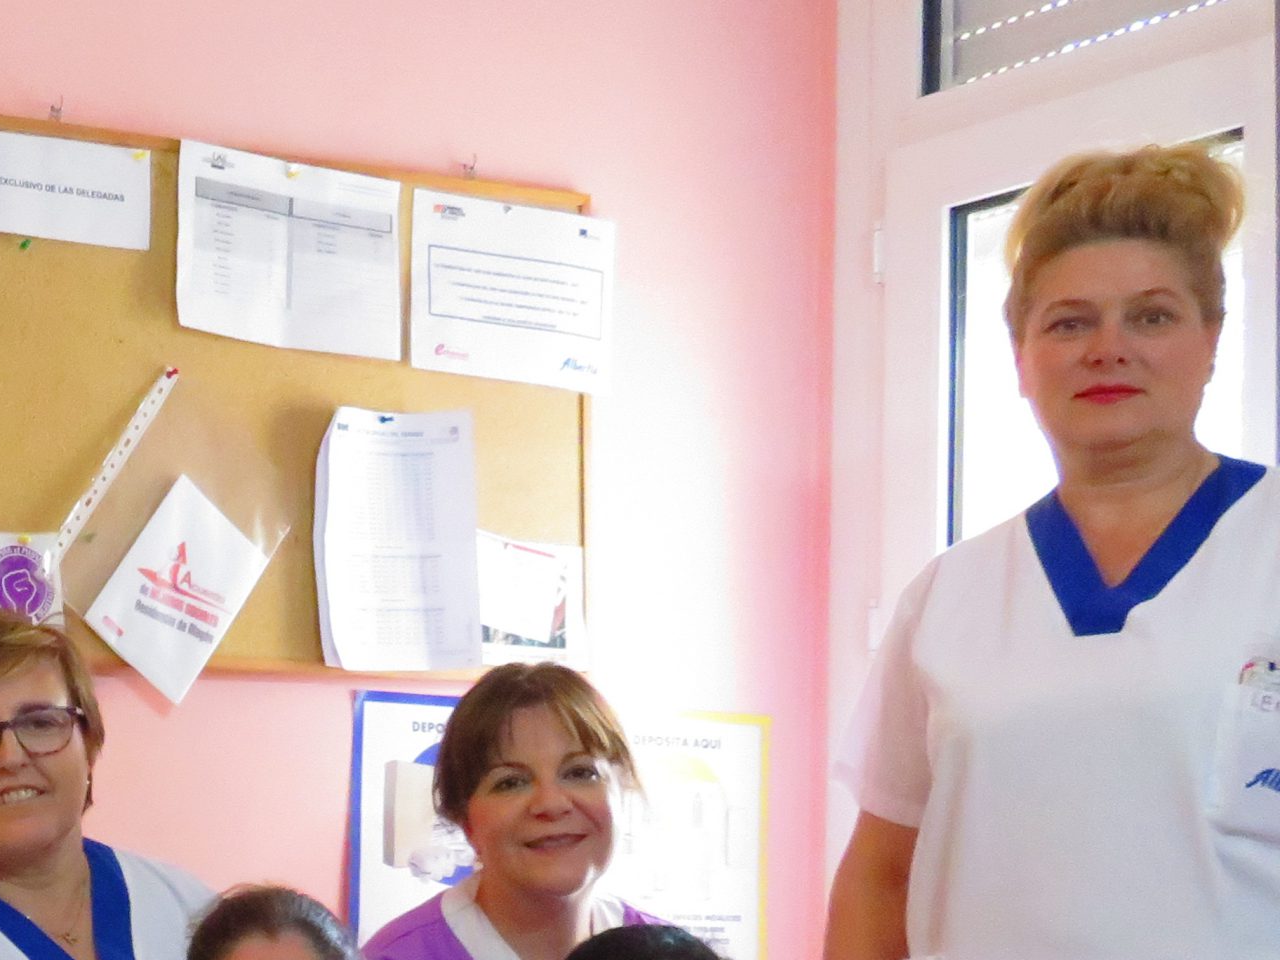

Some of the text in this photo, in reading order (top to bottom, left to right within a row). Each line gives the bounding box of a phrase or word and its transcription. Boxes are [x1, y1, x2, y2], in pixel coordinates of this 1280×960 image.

[44, 184, 57, 193] DE
[58, 186, 74, 196] LAS
[76, 187, 126, 202] DELEGADAS
[412, 721, 446, 735] DEPO
[632, 735, 689, 748] DEPOSITA
